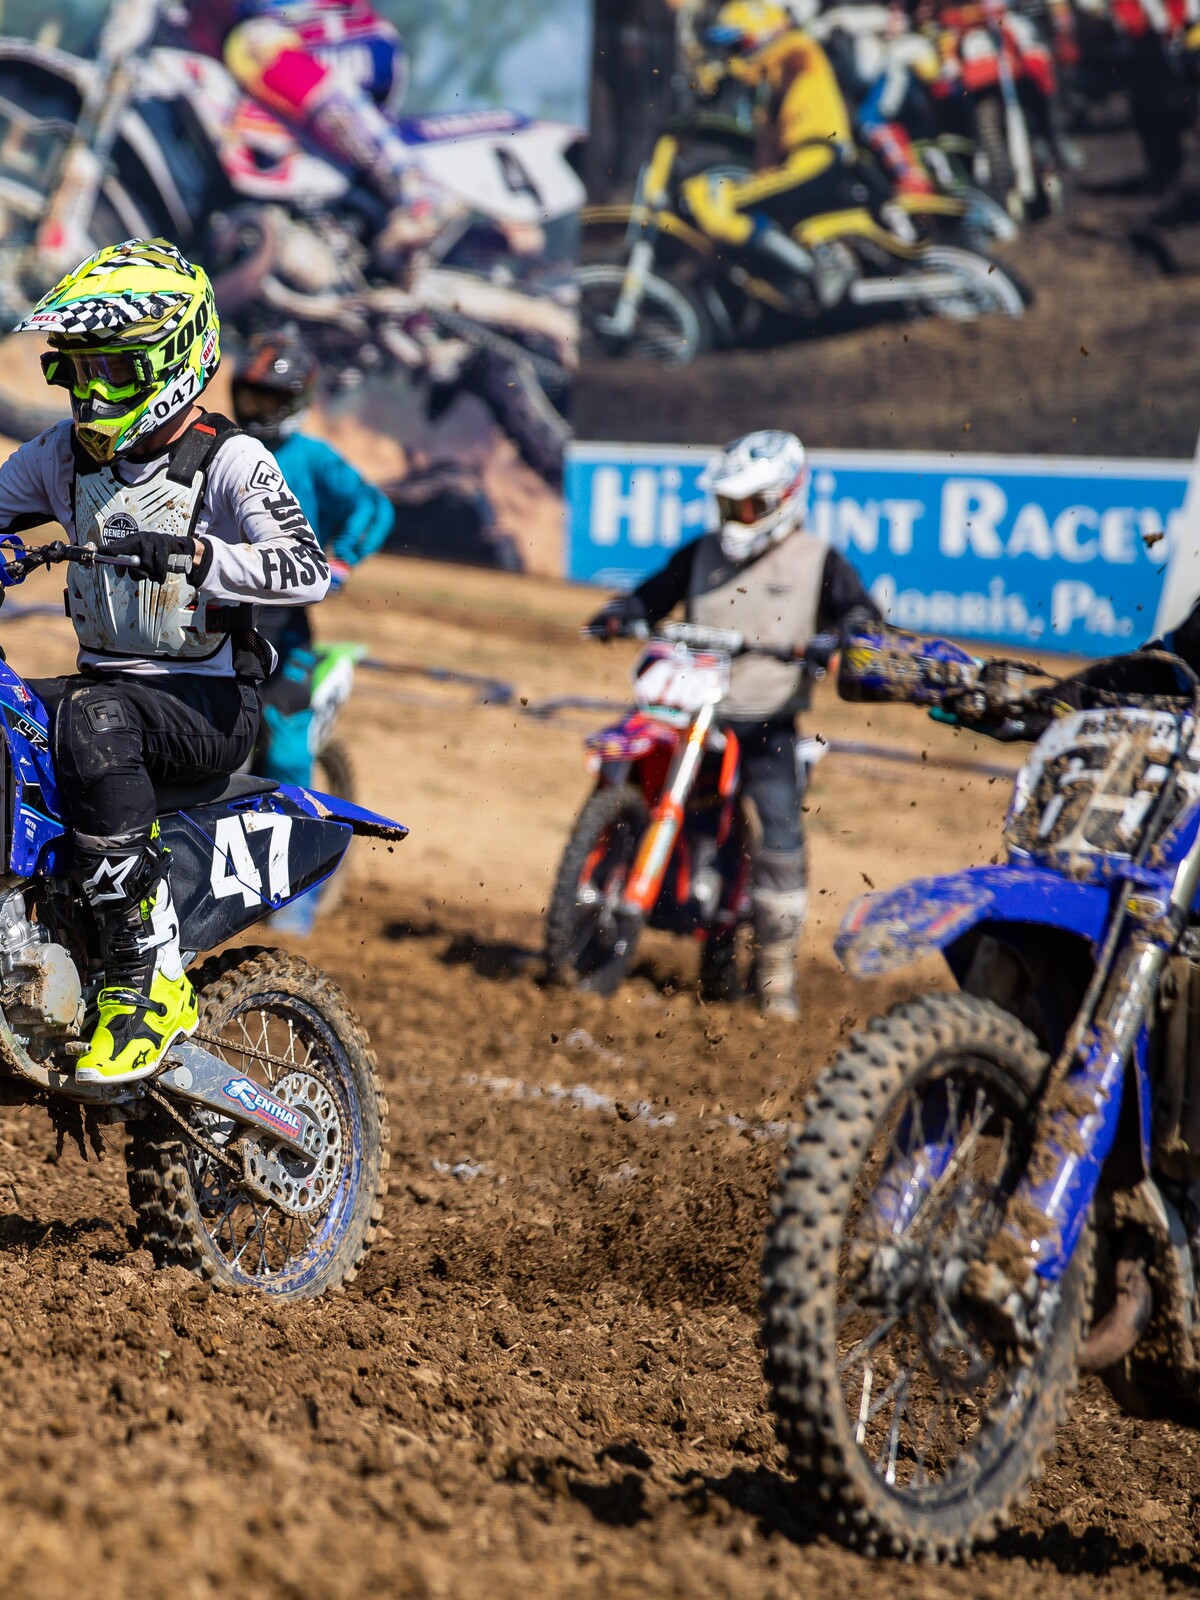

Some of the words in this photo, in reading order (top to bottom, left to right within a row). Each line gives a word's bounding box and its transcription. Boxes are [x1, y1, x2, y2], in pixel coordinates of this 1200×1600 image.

[31, 314, 58, 322] BELL
[202, 335, 216, 363] BELL
[153, 374, 195, 419] 047
[210, 812, 293, 908] 47
